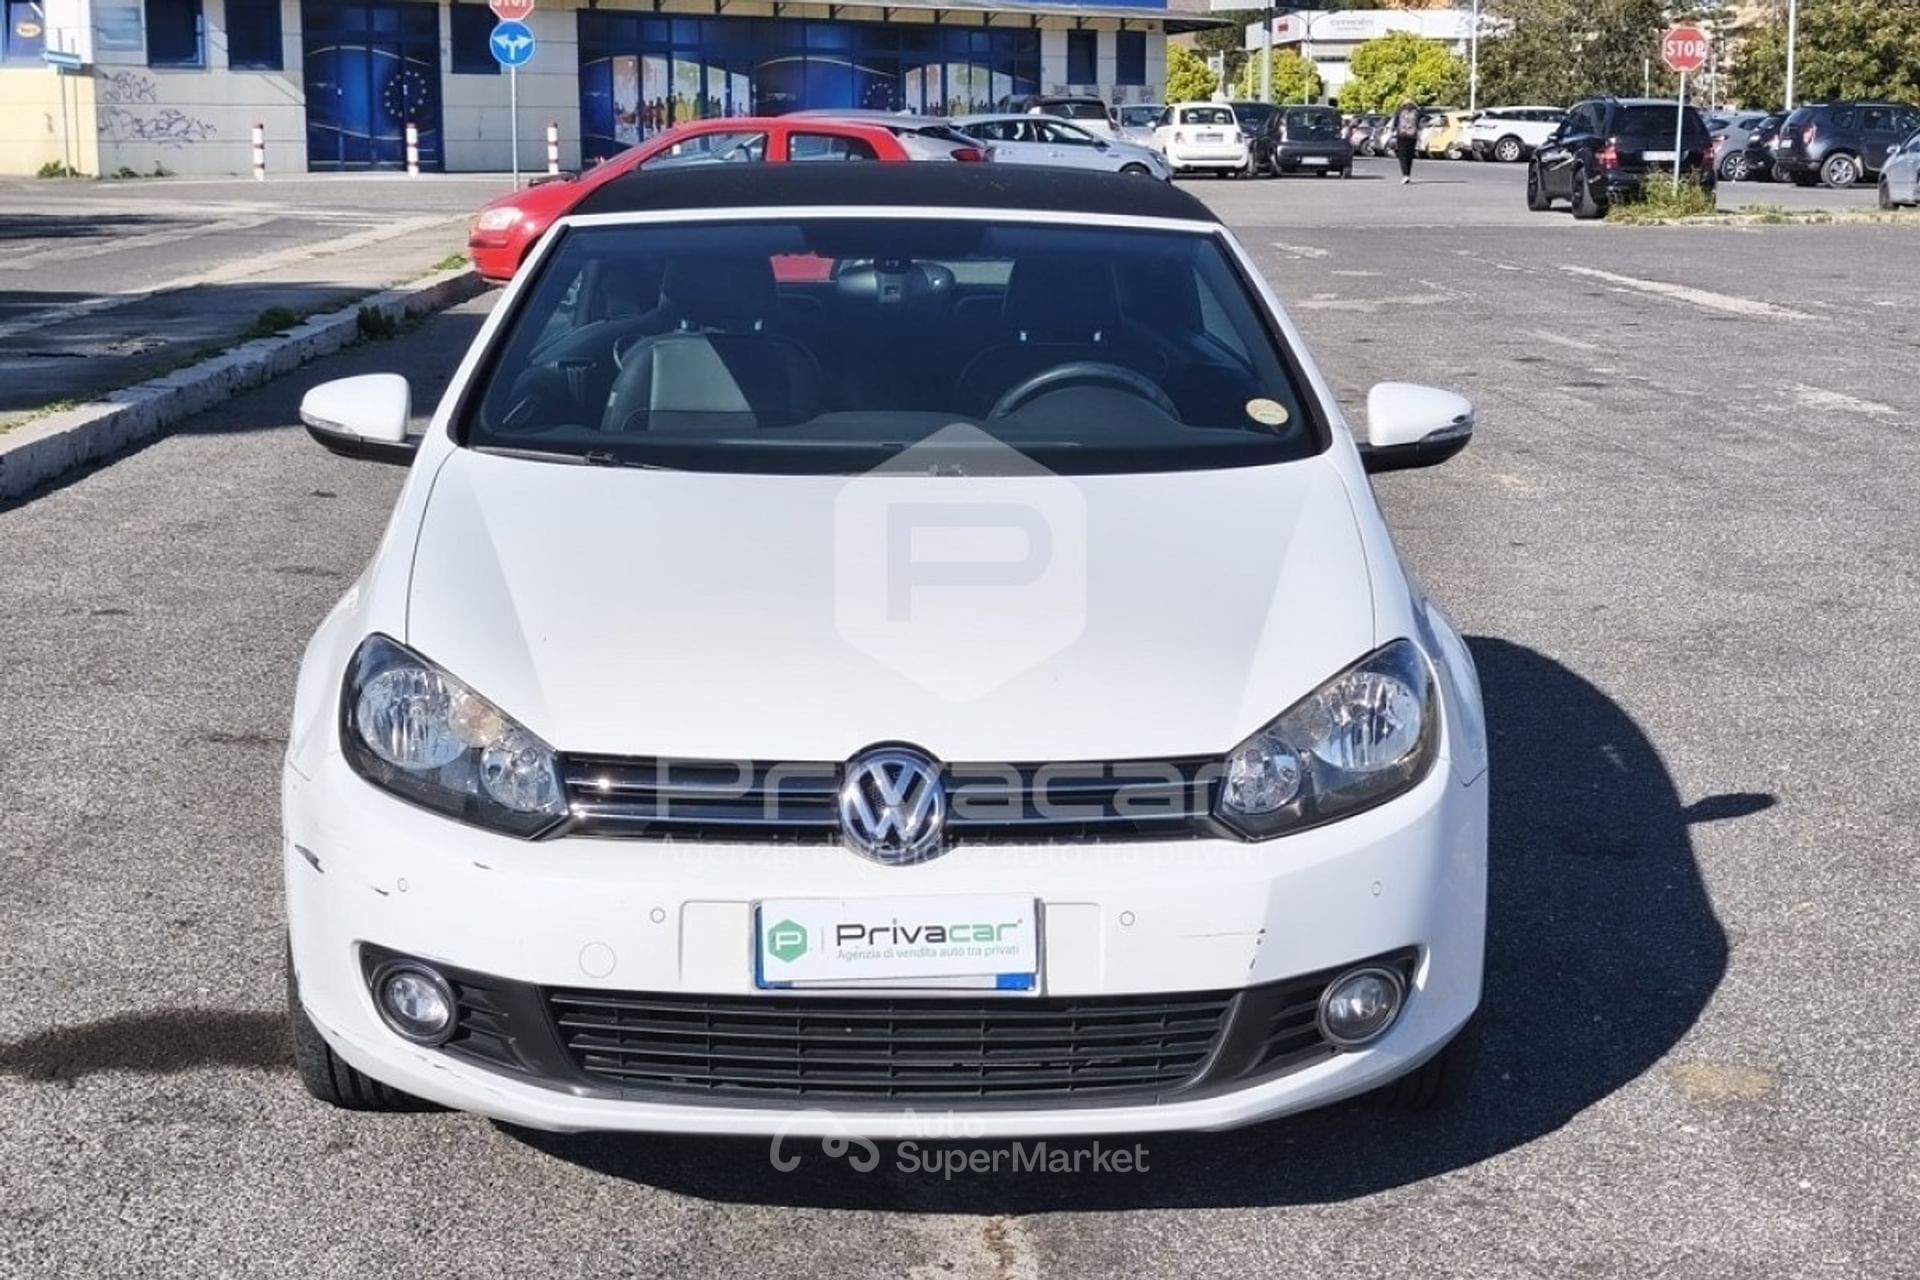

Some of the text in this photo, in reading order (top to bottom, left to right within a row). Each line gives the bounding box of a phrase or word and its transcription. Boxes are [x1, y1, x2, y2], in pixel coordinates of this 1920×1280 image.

[1667, 40, 1706, 57] STOP
[836, 918, 1018, 946] Privacar
[837, 949, 881, 962] Agenzia
[896, 947, 937, 959] vendita
